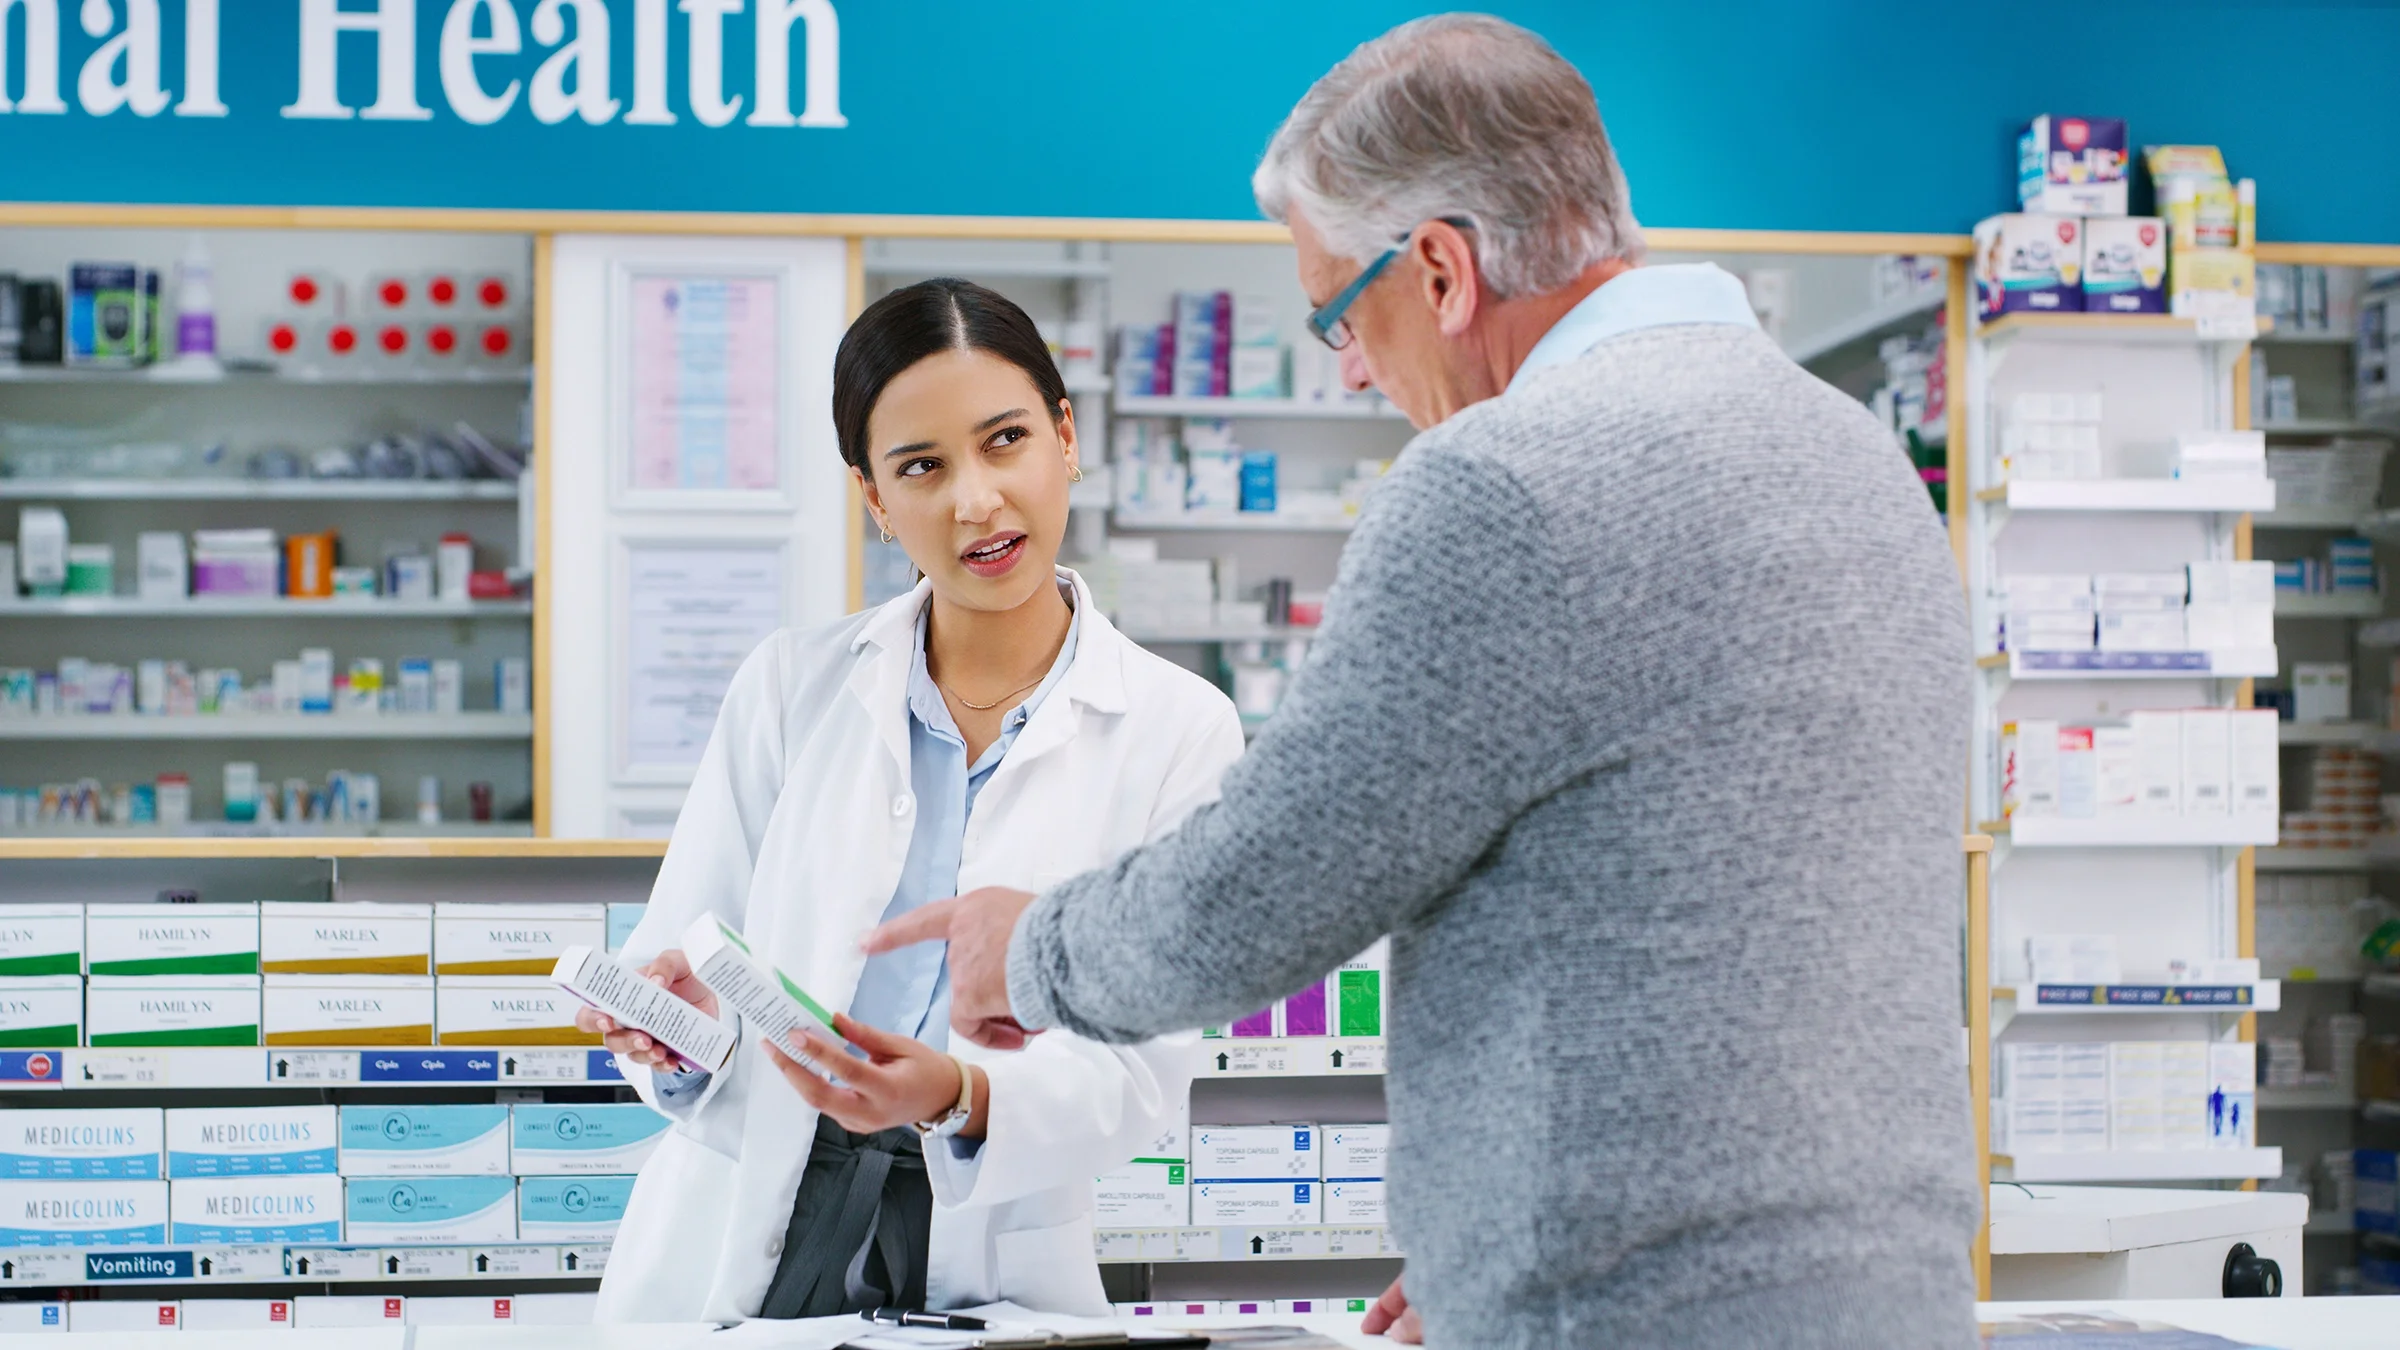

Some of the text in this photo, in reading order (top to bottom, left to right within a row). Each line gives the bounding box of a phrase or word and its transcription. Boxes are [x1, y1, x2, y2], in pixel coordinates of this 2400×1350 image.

[280, 0, 849, 128] Health
[138, 928, 211, 941] HAMILYN
[314, 929, 379, 942] MARLEX
[488, 930, 553, 943] MARLEX
[140, 1000, 212, 1013] HAMILYN
[318, 999, 383, 1012] MARLEX
[491, 999, 556, 1012] MARLEX
[25, 1126, 136, 1146] MEDICOLINS
[201, 1122, 312, 1144] MEDICOLINS
[25, 1198, 137, 1219] MEDICOLINS
[206, 1195, 316, 1215] MEDICOLINS
[90, 1256, 176, 1275] Vomiting
